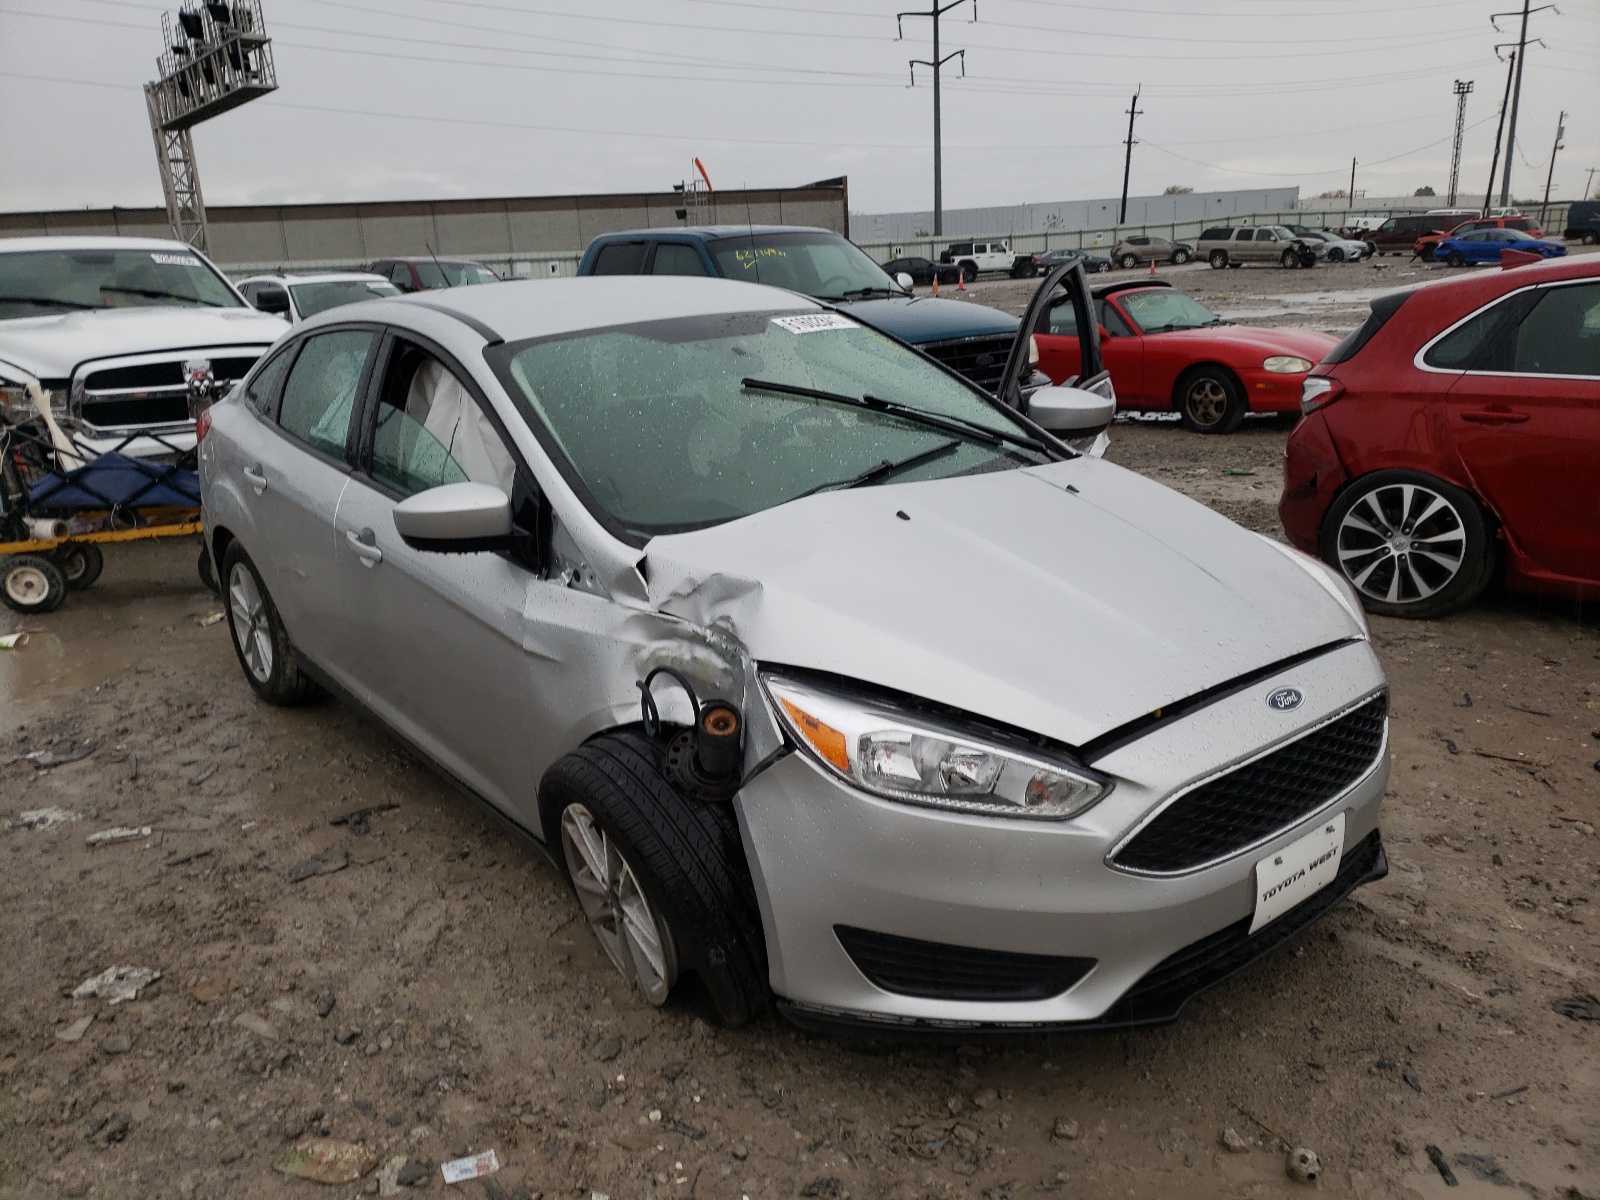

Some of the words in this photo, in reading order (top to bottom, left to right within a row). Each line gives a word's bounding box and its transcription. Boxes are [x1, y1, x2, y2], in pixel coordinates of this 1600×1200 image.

[1275, 691, 1299, 708] Ford
[1262, 868, 1305, 902] TOYOTA
[1309, 846, 1339, 871] WEST
